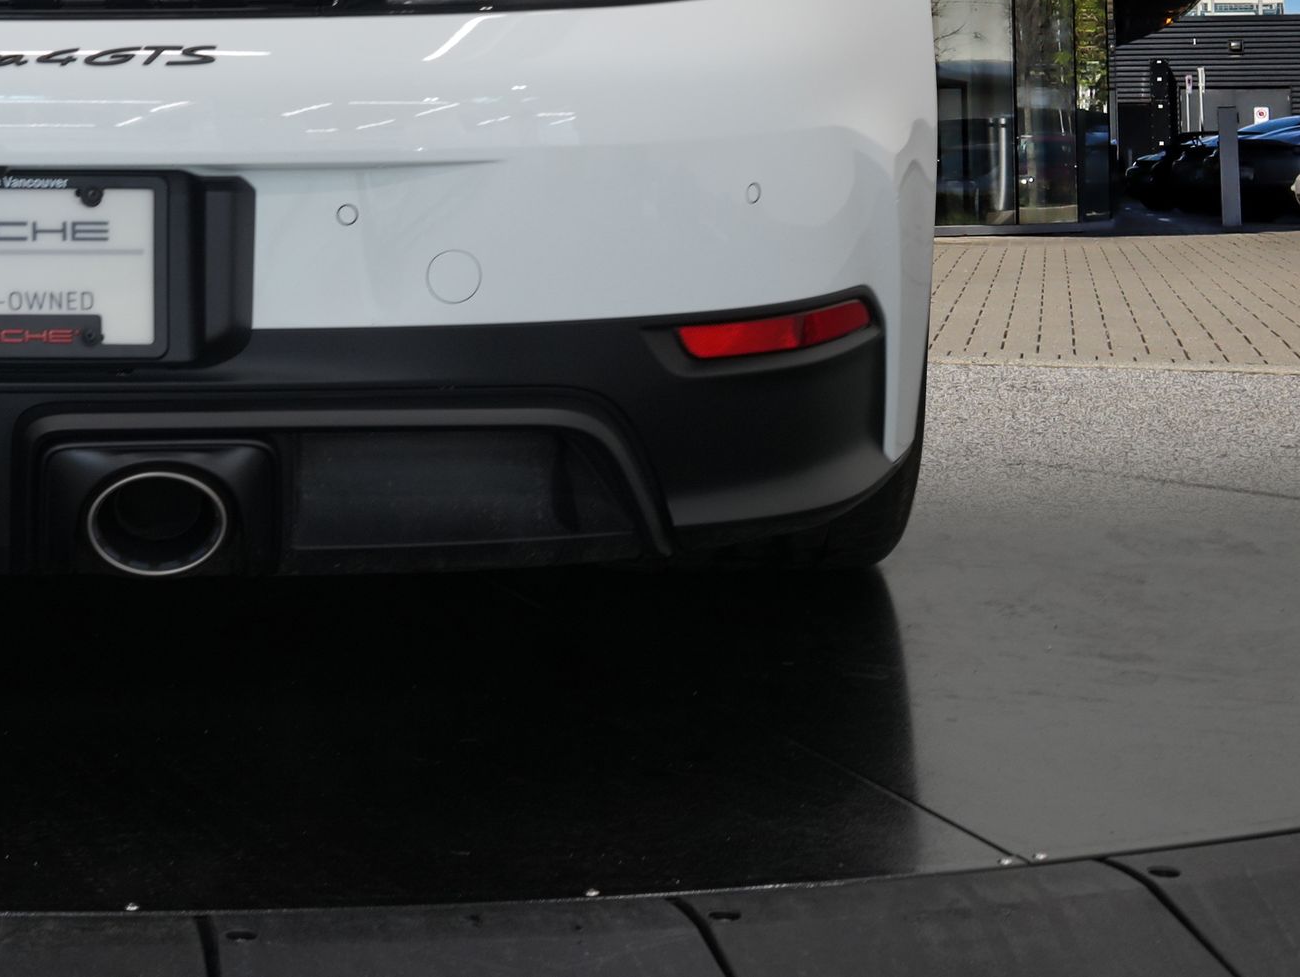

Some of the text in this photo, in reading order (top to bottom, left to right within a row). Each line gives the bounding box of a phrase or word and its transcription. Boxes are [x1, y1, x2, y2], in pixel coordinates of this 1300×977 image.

[36, 48, 80, 66] 4
[84, 45, 217, 66] GTS
[3, 176, 68, 188] Vancouver
